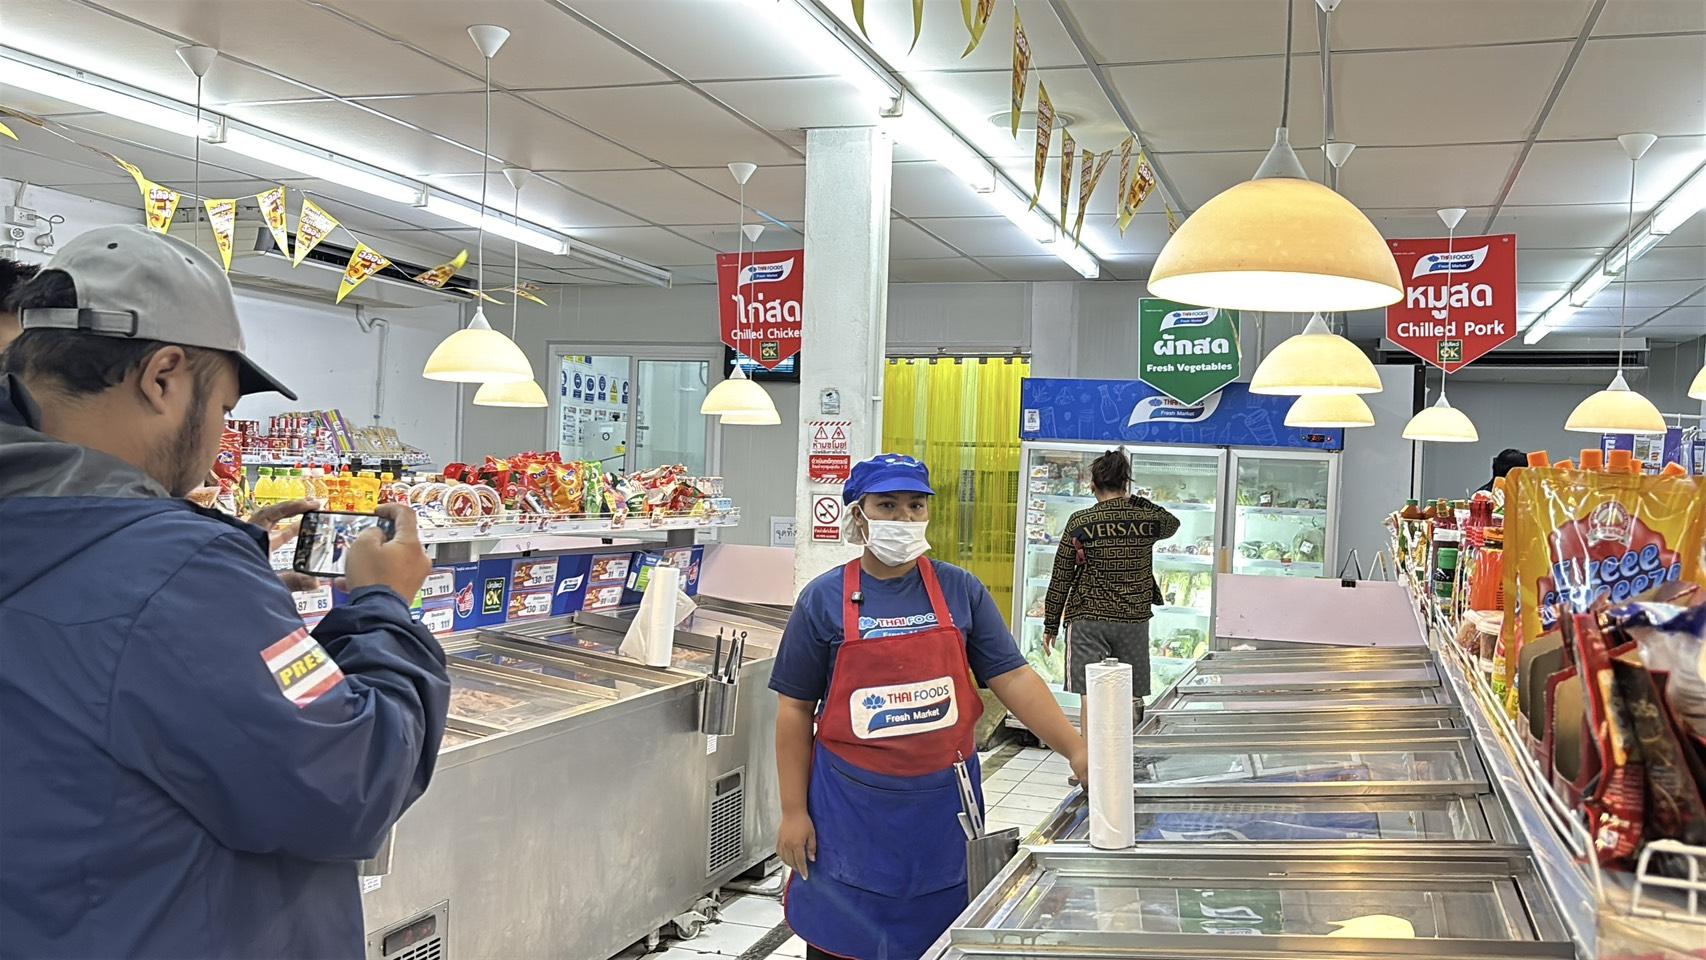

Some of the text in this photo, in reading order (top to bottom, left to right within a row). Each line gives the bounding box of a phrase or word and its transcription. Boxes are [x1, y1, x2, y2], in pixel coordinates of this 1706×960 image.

[731, 292, 801, 324] ไก่สด
[1406, 283, 1493, 320] หมูสด
[731, 328, 764, 340] Chilled
[1397, 320, 1504, 338] Chilled Pork
[1153, 334, 1230, 356] ผักสด
[1146, 362, 1232, 374] Fresh Vegetables
[1083, 522, 1154, 539] VERSACE
[318, 599, 327, 608] 85
[878, 612, 938, 628] THAI FOO
[887, 684, 950, 704] THAI FOODS
[885, 707, 940, 723] Fresh Market
